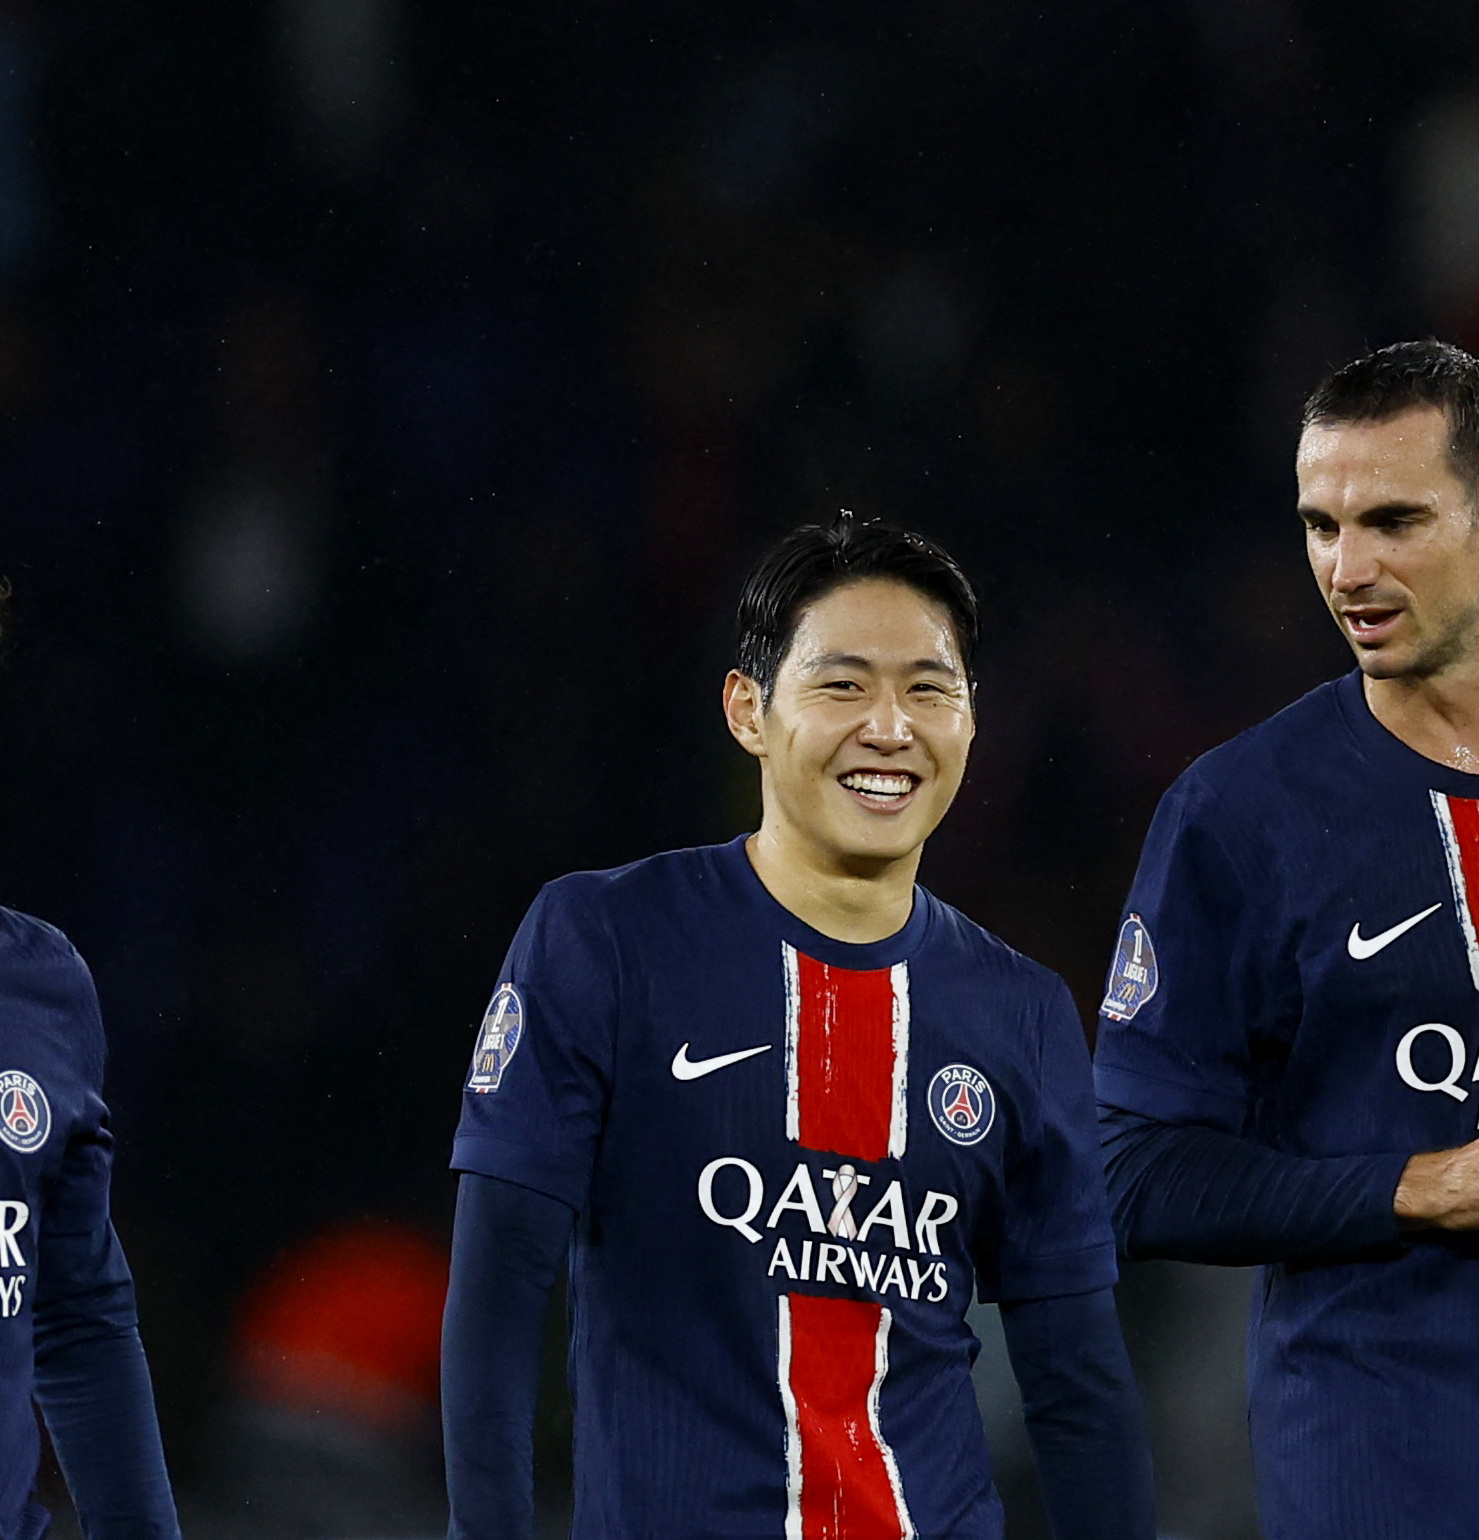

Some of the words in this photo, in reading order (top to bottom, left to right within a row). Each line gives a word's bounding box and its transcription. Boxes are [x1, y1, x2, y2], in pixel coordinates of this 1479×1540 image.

[941, 1069, 986, 1093] PARIS
[698, 1157, 958, 1256] QATAR
[768, 1238, 948, 1302] AIRWAYS
